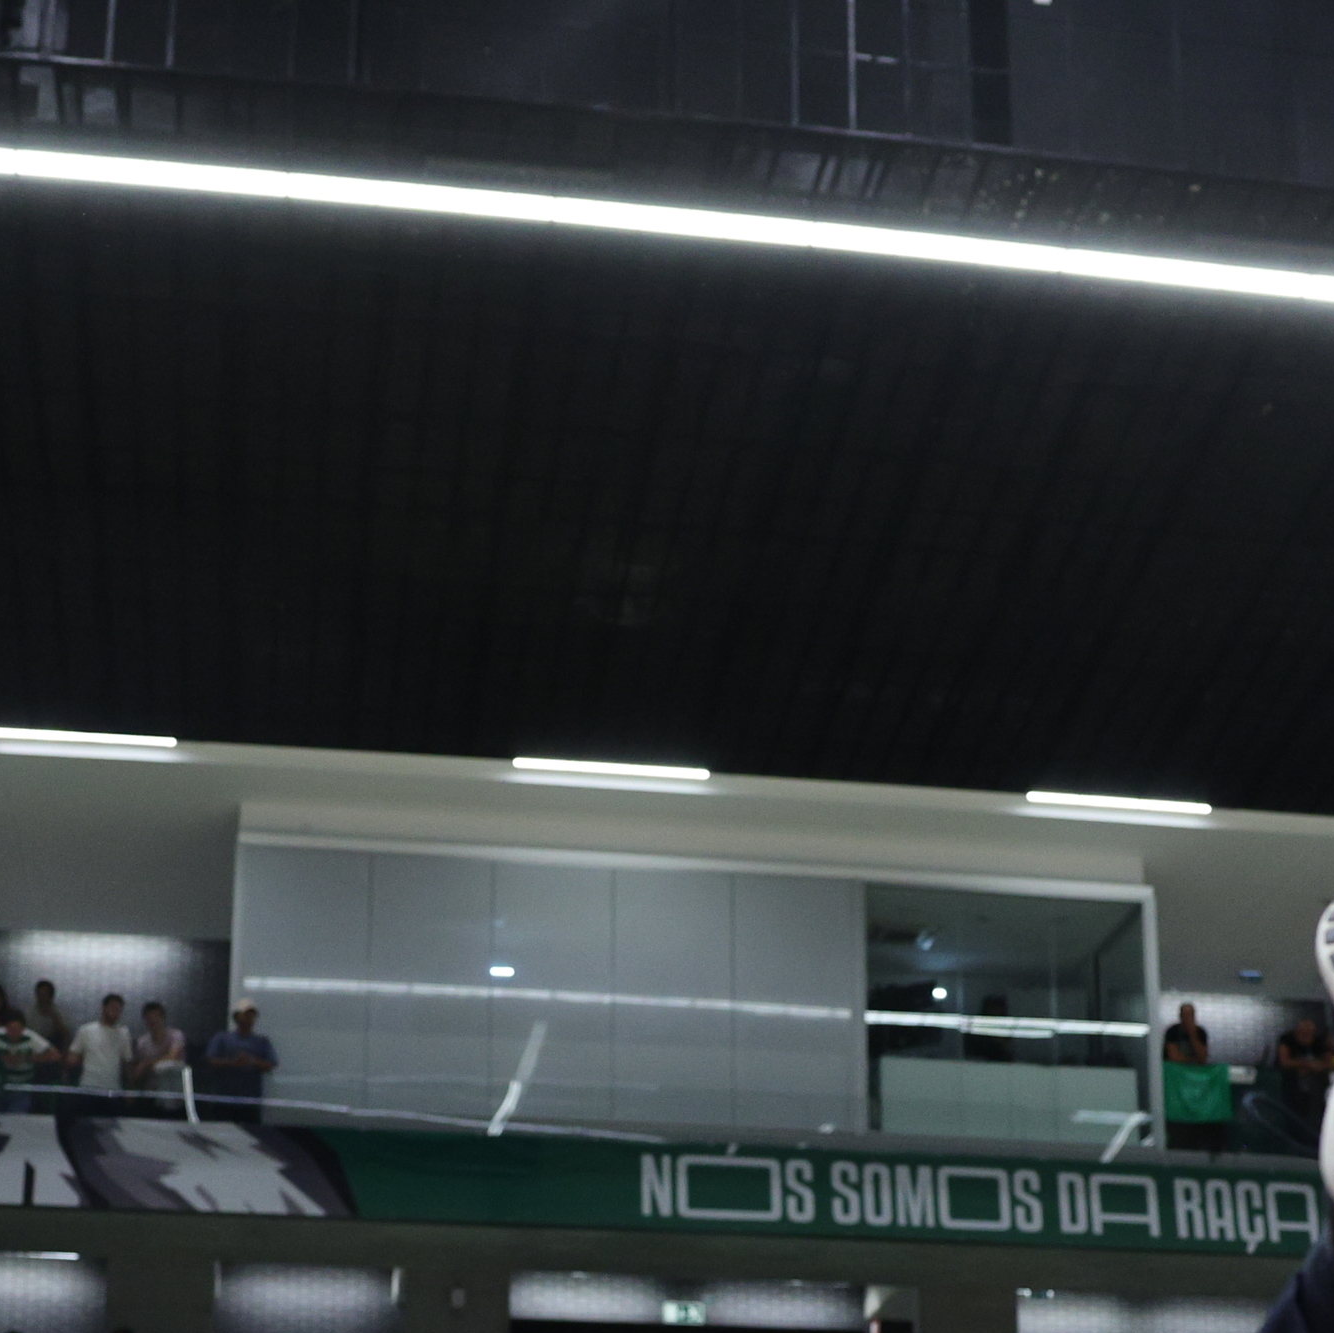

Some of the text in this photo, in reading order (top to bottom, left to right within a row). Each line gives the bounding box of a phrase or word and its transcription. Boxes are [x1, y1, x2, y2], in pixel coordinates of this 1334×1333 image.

[640, 1143, 816, 1224] NÓS
[830, 1161, 1044, 1233] SOMOS
[1058, 1173, 1161, 1237] DA
[1175, 1177, 1319, 1254] RAÇA
